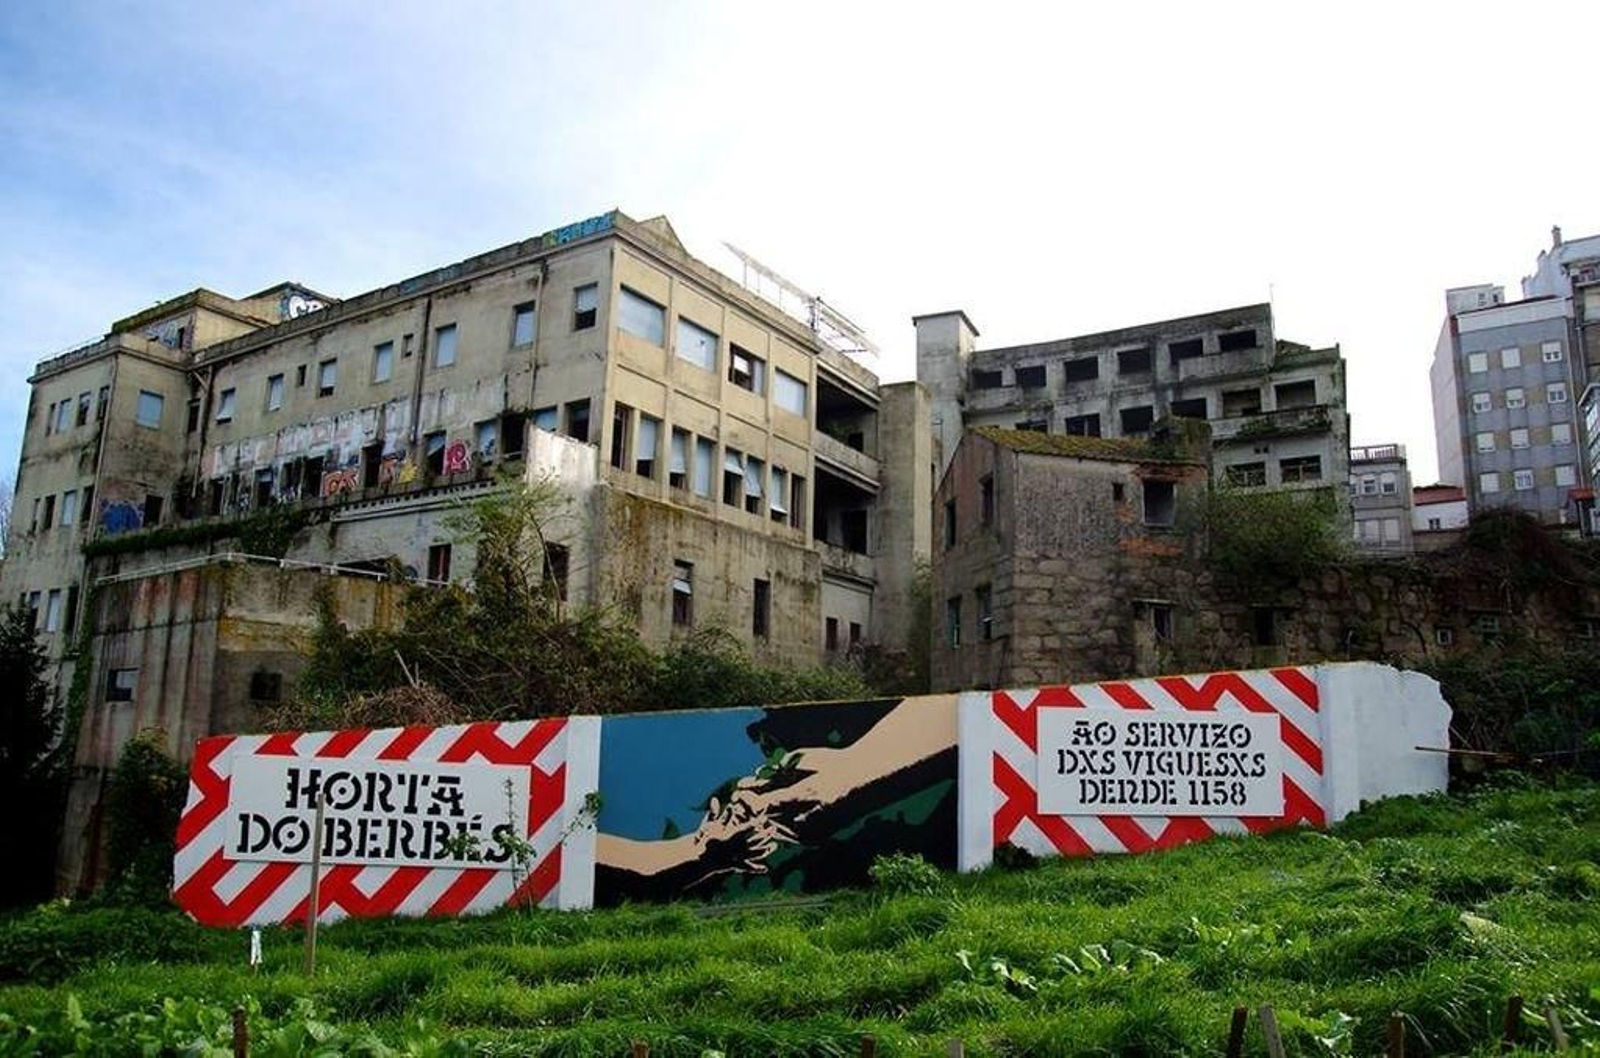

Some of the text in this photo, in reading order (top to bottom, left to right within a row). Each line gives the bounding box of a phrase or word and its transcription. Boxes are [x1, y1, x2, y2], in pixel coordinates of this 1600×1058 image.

[1071, 720, 1251, 748] AO SERVIZO
[1057, 749, 1266, 777] DXS VIGUESXS
[285, 768, 464, 816] HORTA
[1189, 781, 1247, 806] 1158
[236, 813, 310, 855] DO
